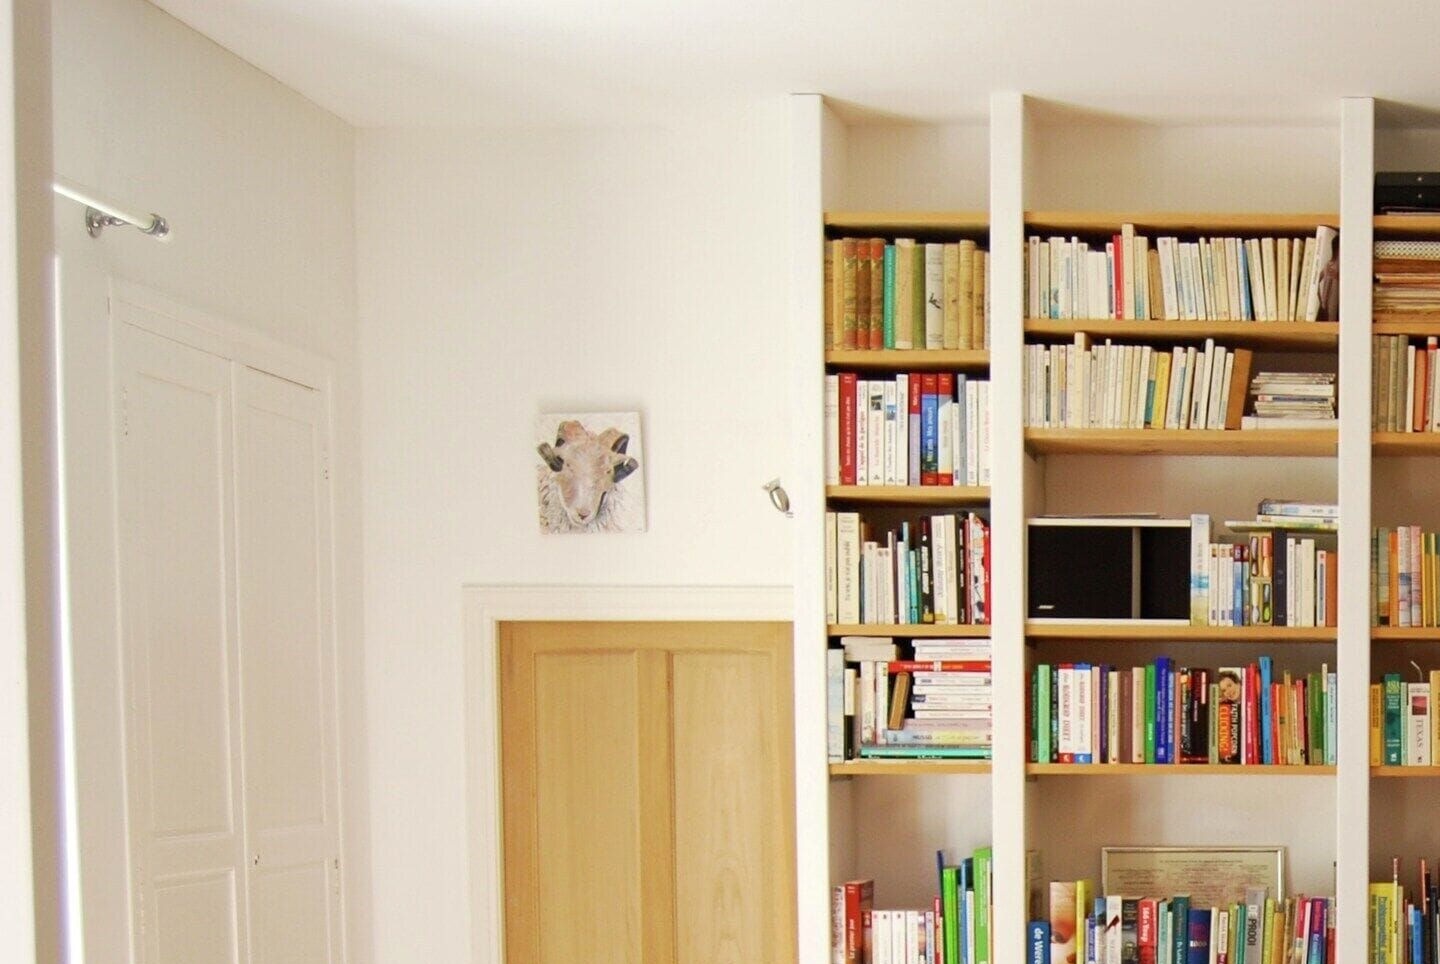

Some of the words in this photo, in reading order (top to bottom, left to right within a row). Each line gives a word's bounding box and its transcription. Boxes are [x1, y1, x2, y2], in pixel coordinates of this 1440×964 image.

[1219, 706, 1228, 752] CLICKING!
[1416, 719, 1424, 748] TEXAS
[1247, 904, 1258, 917] DE
[1034, 928, 1044, 940] de
[1247, 918, 1257, 946] PROOI
